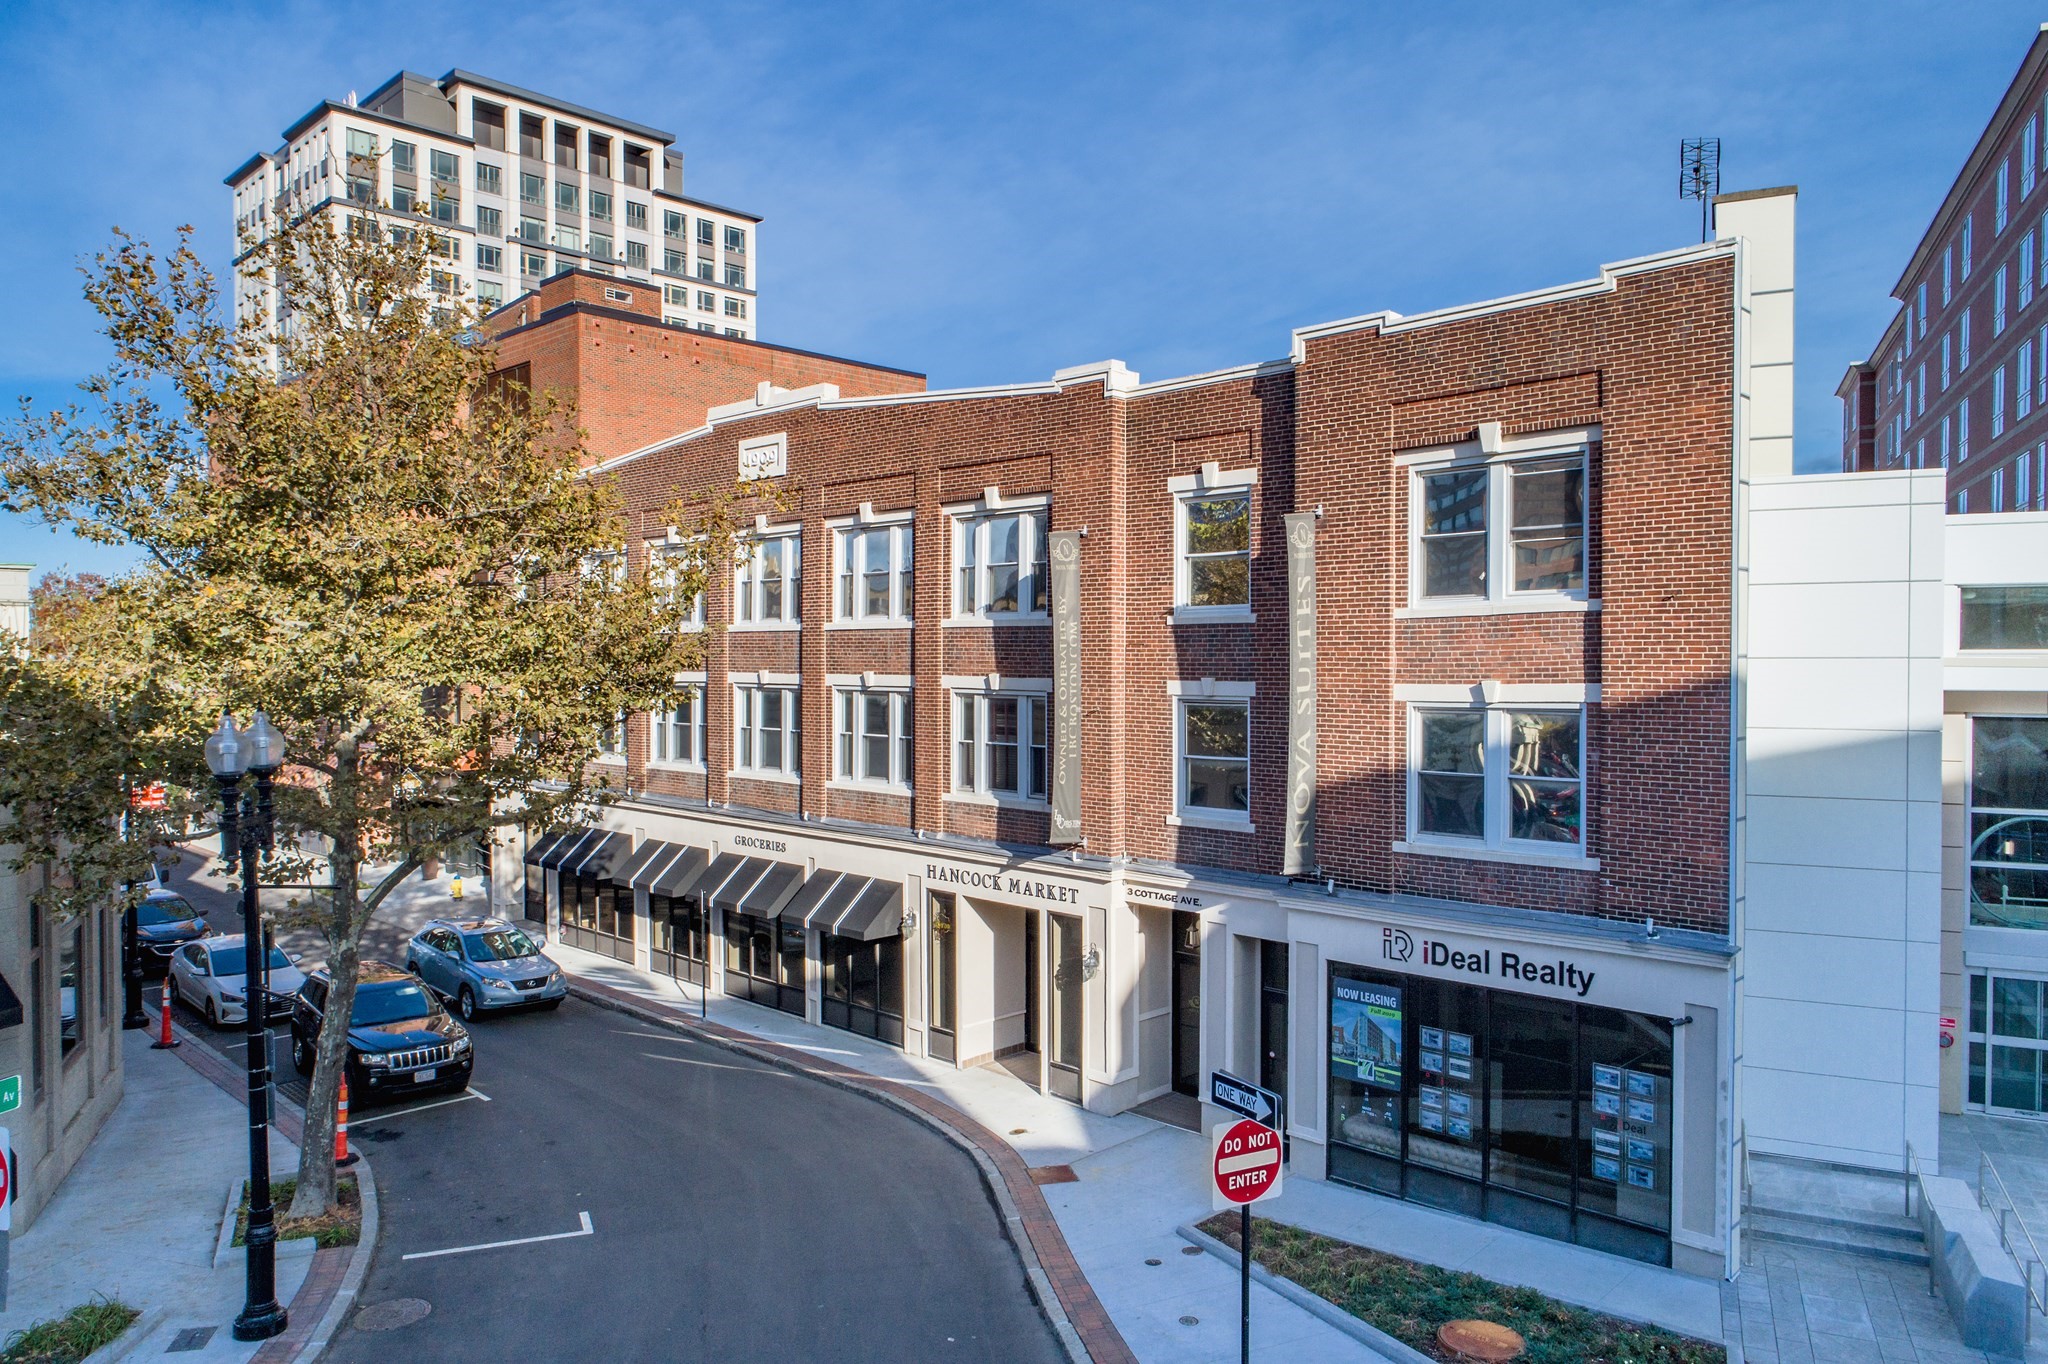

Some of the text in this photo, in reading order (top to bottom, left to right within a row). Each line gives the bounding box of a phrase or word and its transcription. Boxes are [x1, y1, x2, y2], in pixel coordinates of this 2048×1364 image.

[1297, 576, 1311, 715] SUITES
[1058, 595, 1068, 785] OWNED & OPERATED BY
[1293, 729, 1311, 848] NOVA
[734, 835, 787, 852] GROCERIES
[926, 864, 1079, 904] HANCOCK MARKET
[1134, 889, 1179, 903] COTTAGE
[1180, 896, 1202, 907] AVE.
[1423, 940, 1595, 997] iDeal Realty
[1337, 987, 1397, 1008] NOW LEASING
[1217, 1083, 1257, 1111] ONE WAY
[1224, 1131, 1273, 1154] DO NOT
[1228, 1169, 1268, 1190] ENTER
